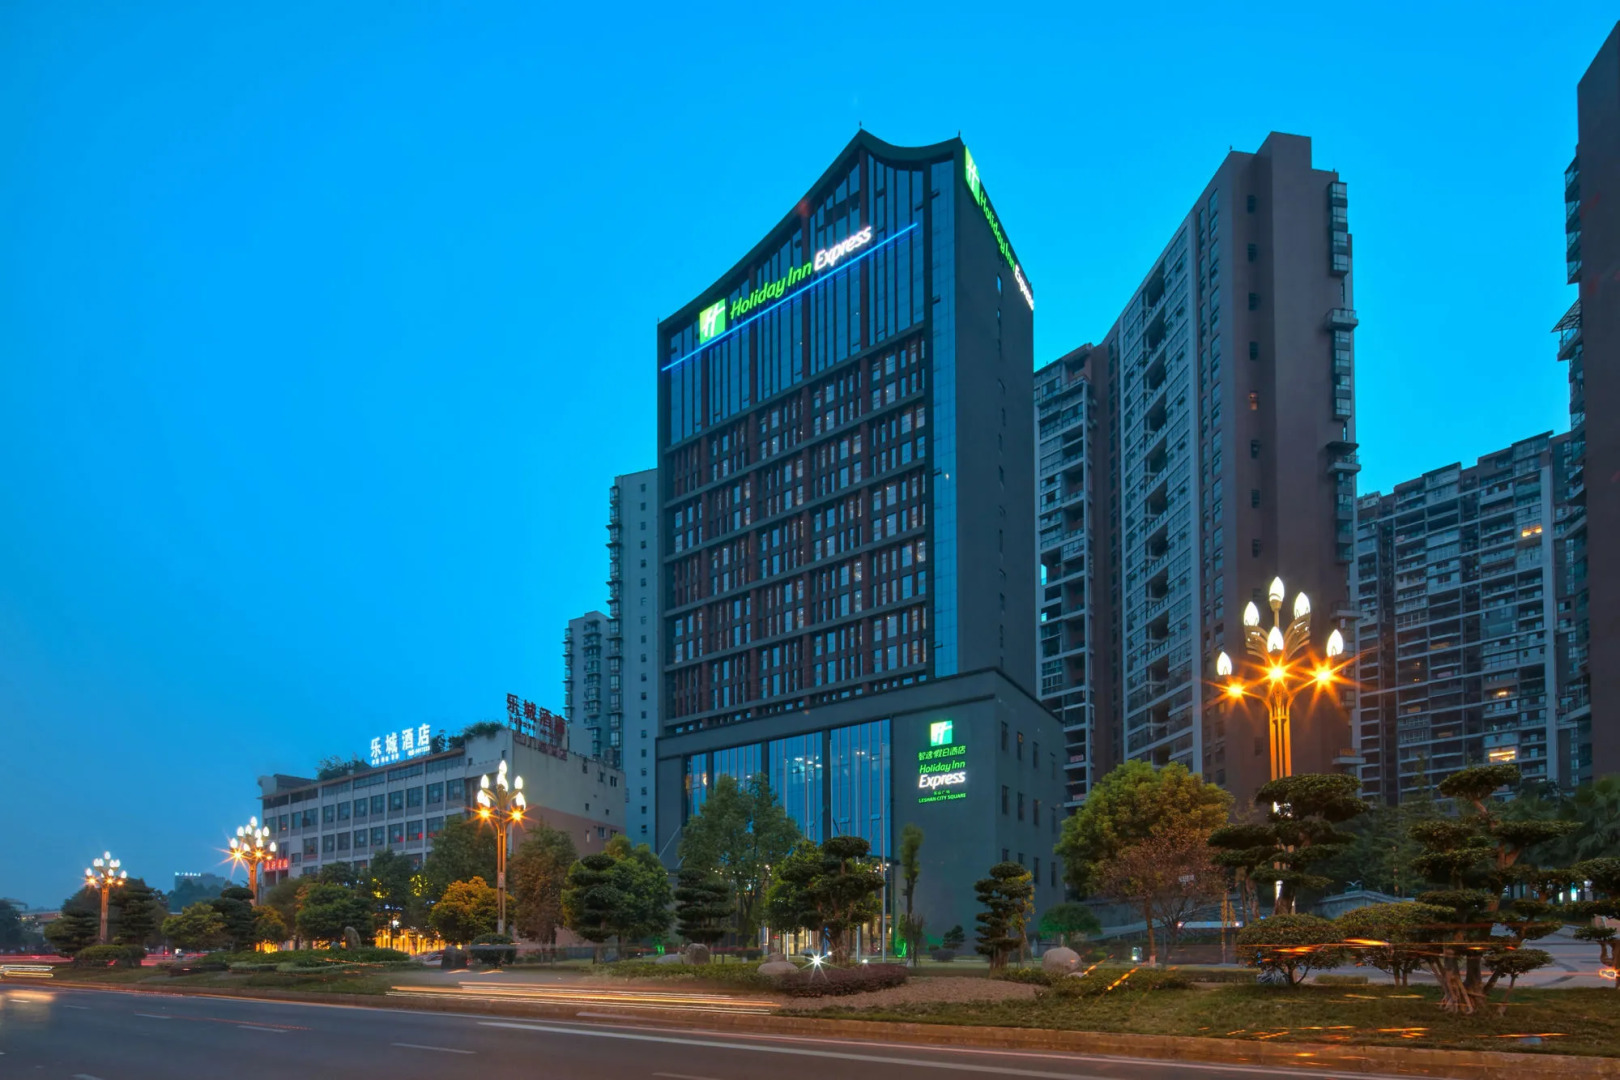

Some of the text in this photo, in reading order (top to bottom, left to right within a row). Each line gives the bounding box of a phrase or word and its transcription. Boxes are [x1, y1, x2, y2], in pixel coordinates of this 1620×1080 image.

[980, 191, 1006, 254] Holiday
[1005, 242, 1016, 272] Inn
[730, 226, 872, 320] Holiday Inn Express
[370, 723, 431, 758] 乐城酒店
[920, 760, 966, 773] Holiday Inn
[919, 771, 966, 789] Express
[947, 792, 966, 800] SQUARE
